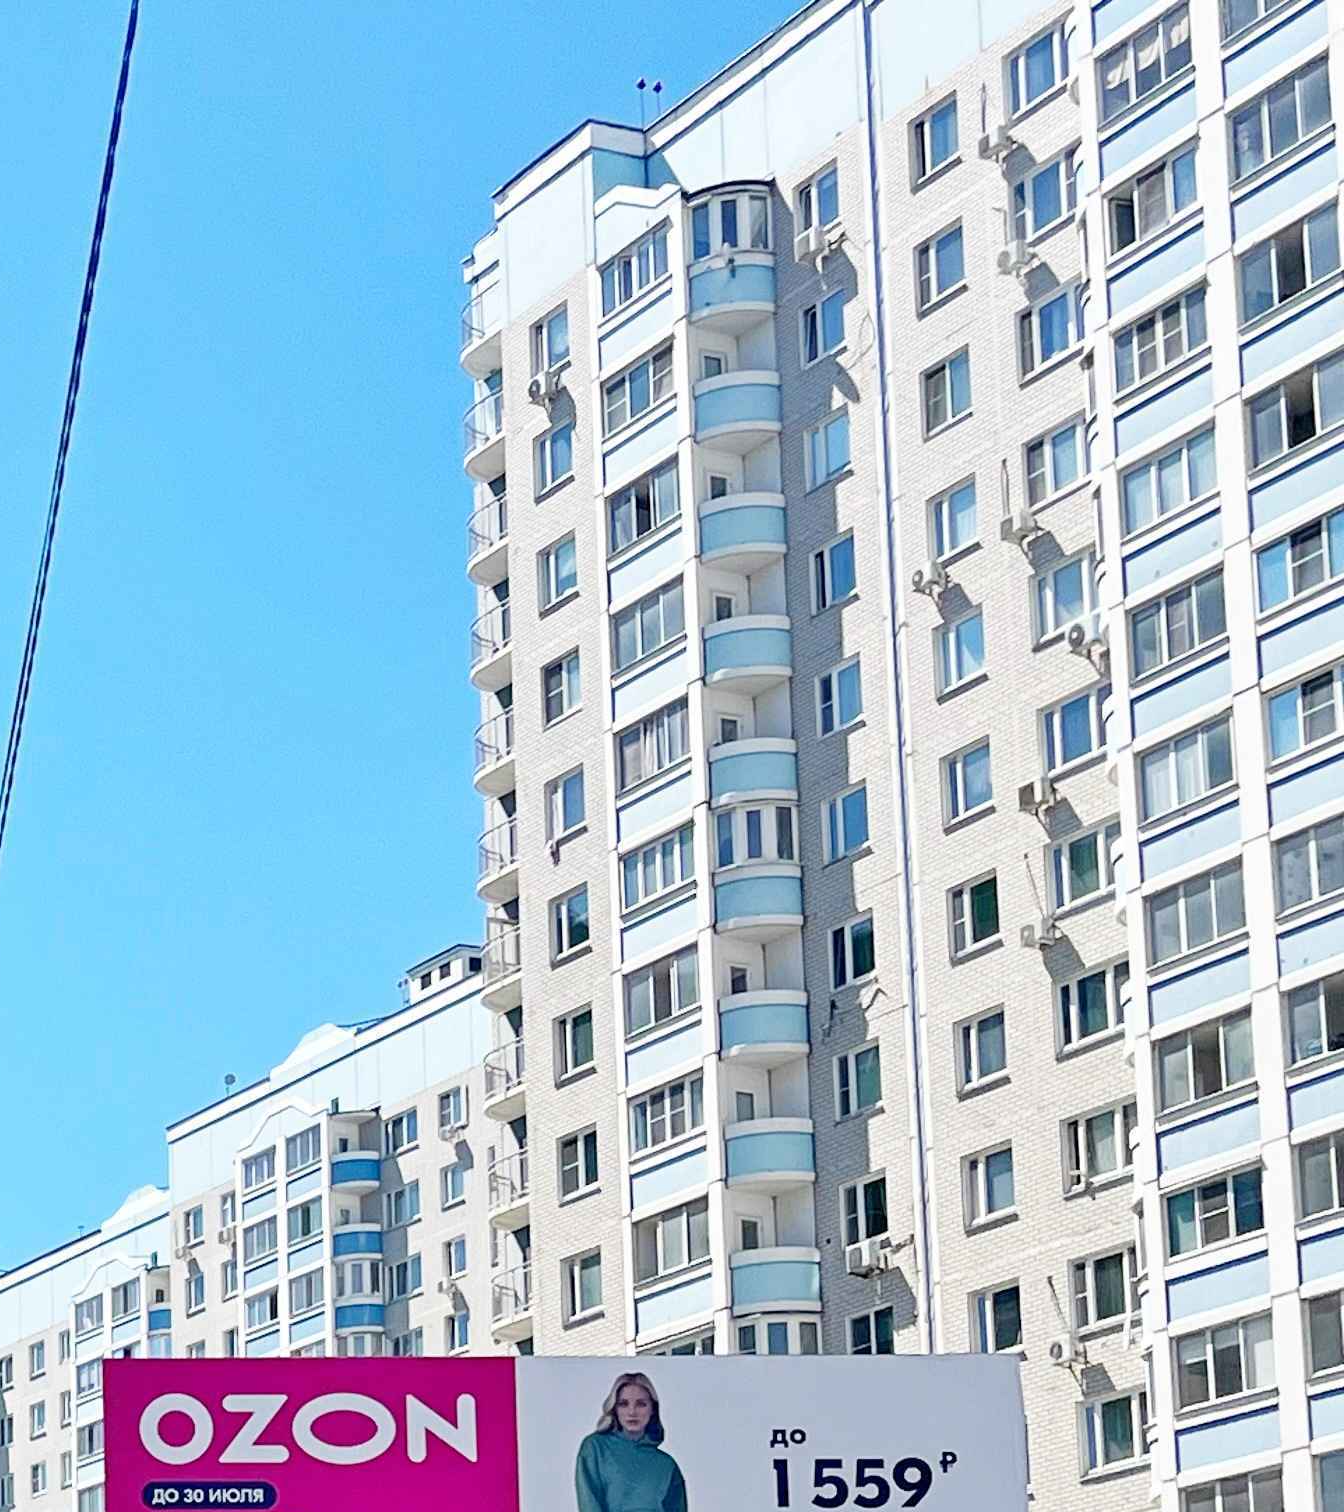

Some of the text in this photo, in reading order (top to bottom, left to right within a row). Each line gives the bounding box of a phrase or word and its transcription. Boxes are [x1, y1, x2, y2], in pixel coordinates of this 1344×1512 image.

[139, 1392, 477, 1465] OZON
[770, 1428, 807, 1448] до
[152, 1488, 264, 1506] ДО 30 ИЮЛЯ
